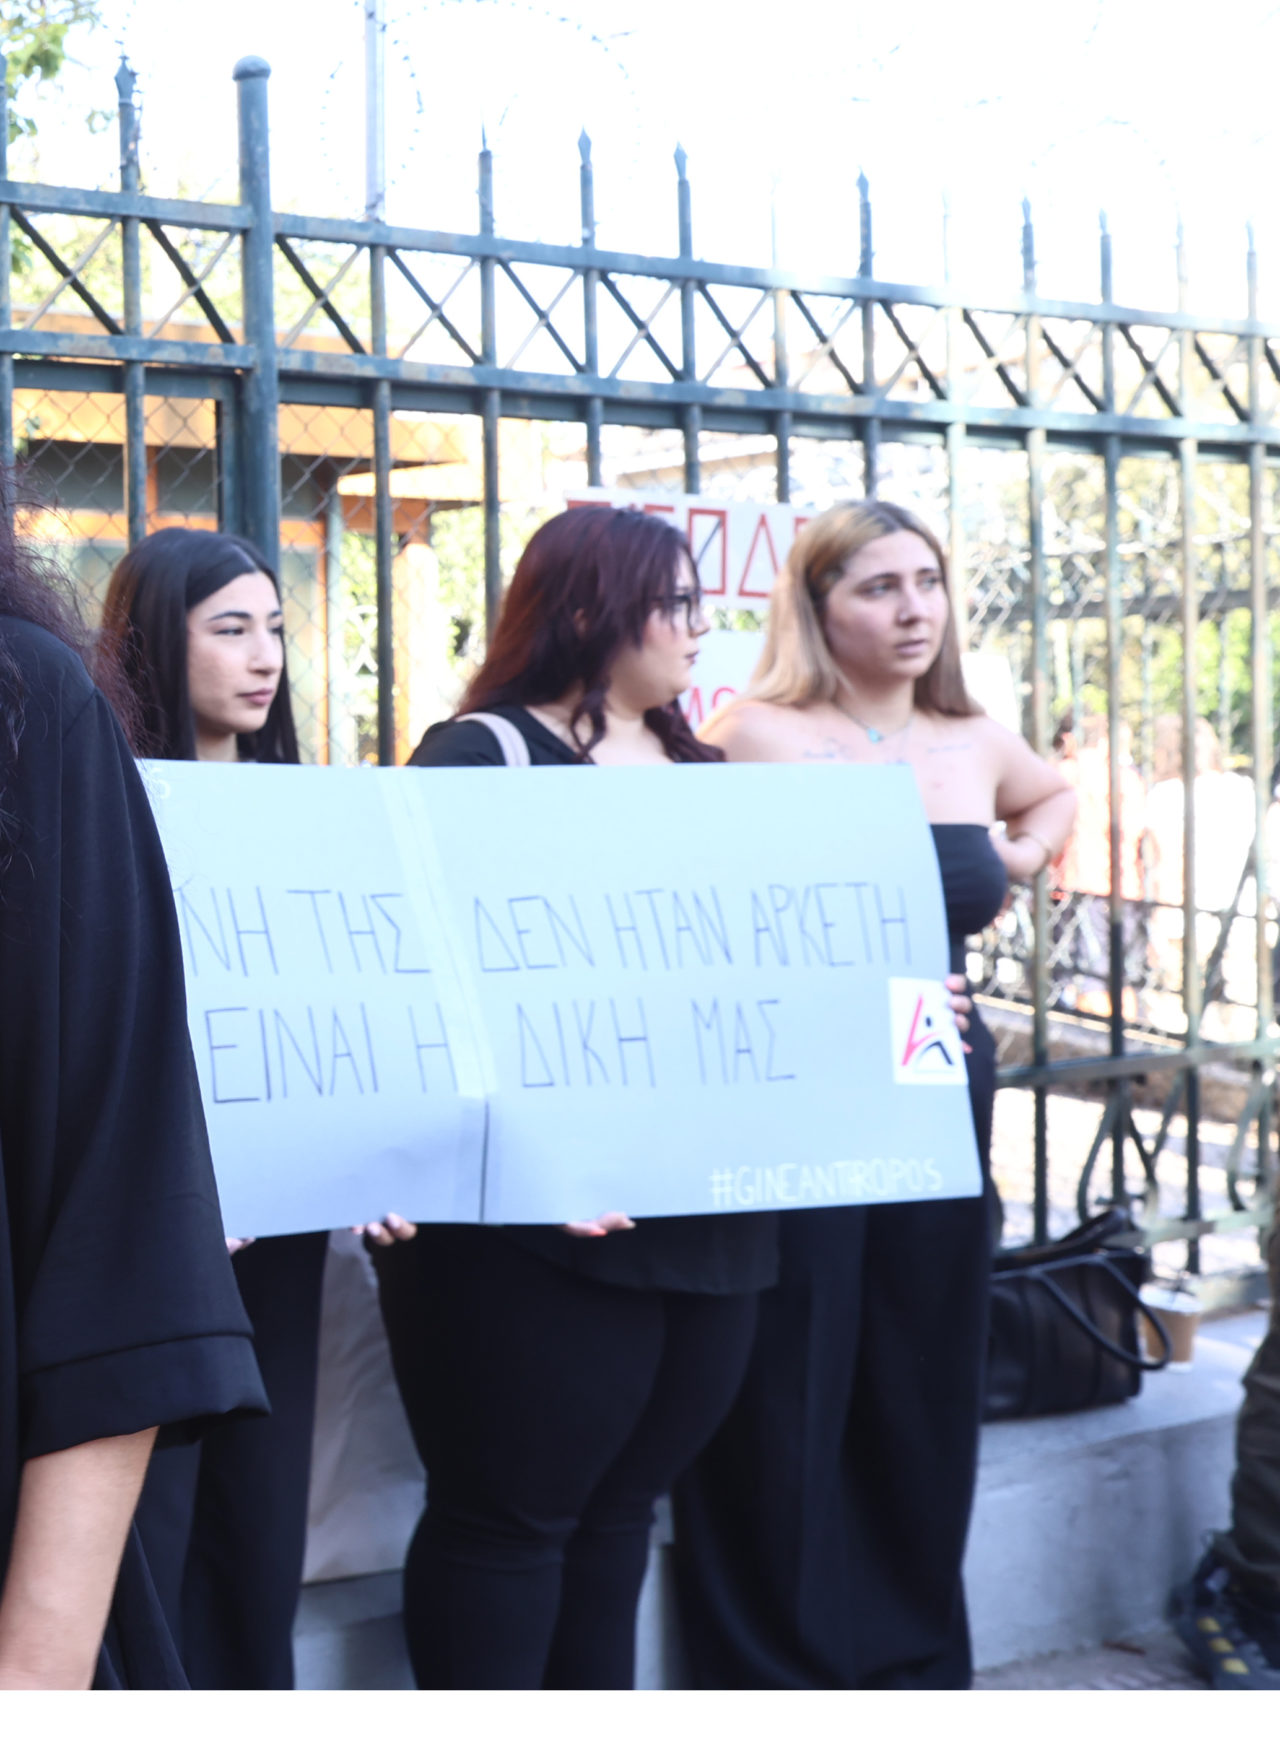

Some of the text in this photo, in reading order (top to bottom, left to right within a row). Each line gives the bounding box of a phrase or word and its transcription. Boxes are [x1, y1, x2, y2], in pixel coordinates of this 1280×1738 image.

[285, 888, 432, 975] ΤΗΣ
[473, 894, 596, 973] ΔΕΝ
[603, 885, 733, 971] ΗΤΑΝ
[750, 881, 913, 967] ΑΡΚΕΤΗ
[204, 996, 798, 1104] ΕΙΝΑΙ Η ΔΙΚΗ ΜΑΣ
[708, 1157, 945, 1208] #GINEANTROPOS
